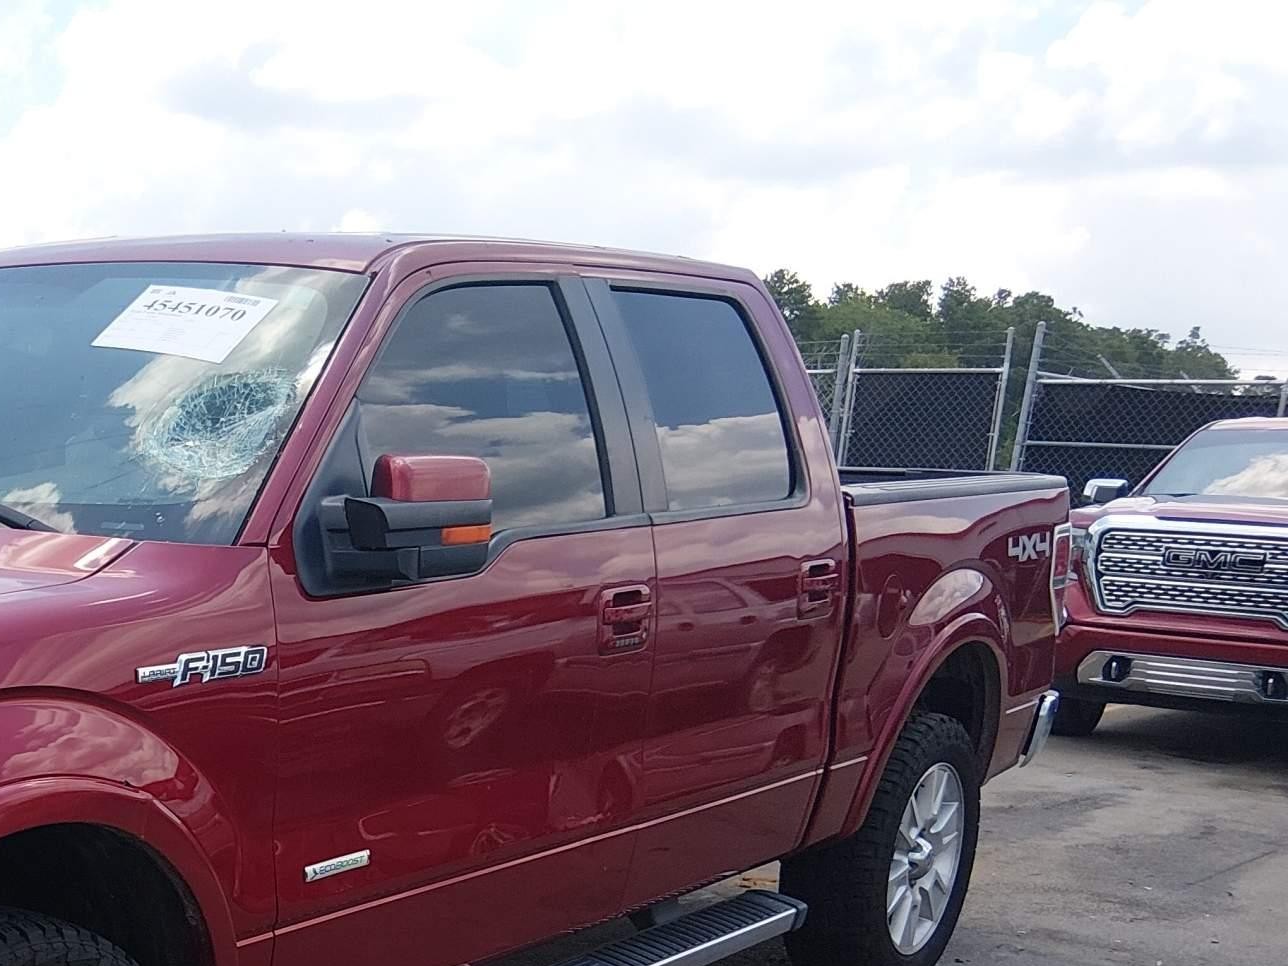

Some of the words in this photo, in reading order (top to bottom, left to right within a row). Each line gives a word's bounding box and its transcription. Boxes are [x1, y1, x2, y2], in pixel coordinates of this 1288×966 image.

[143, 299, 247, 321] 45451070
[1007, 531, 1050, 562] 4X4
[1163, 547, 1268, 573] GMC
[174, 646, 268, 686] F-150
